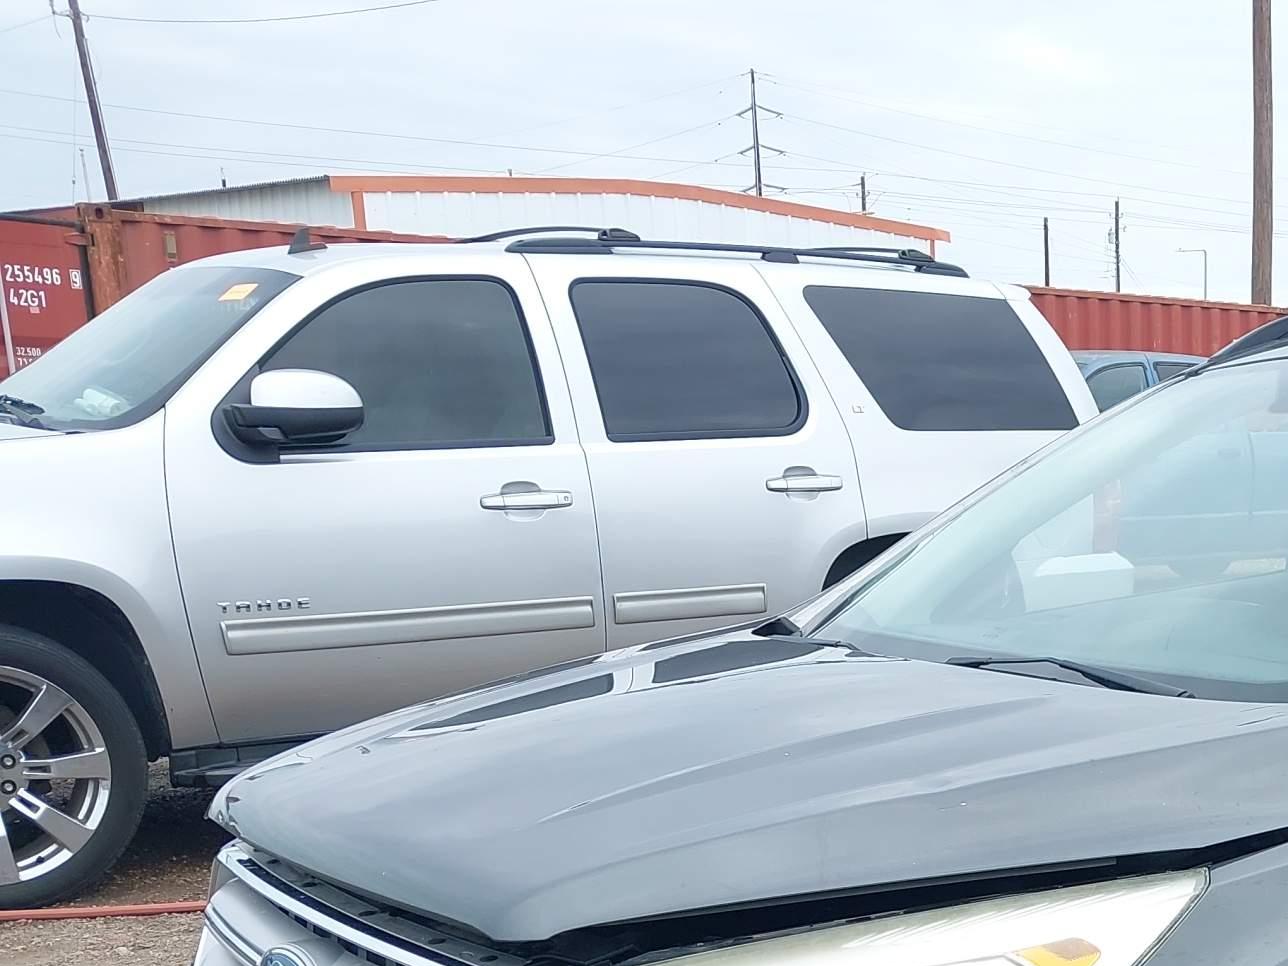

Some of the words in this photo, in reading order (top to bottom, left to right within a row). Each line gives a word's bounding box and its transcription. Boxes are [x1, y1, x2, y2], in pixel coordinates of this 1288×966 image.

[4, 264, 61, 286] 255496
[9, 288, 46, 308] 42G1
[216, 597, 311, 614] TAHOE
